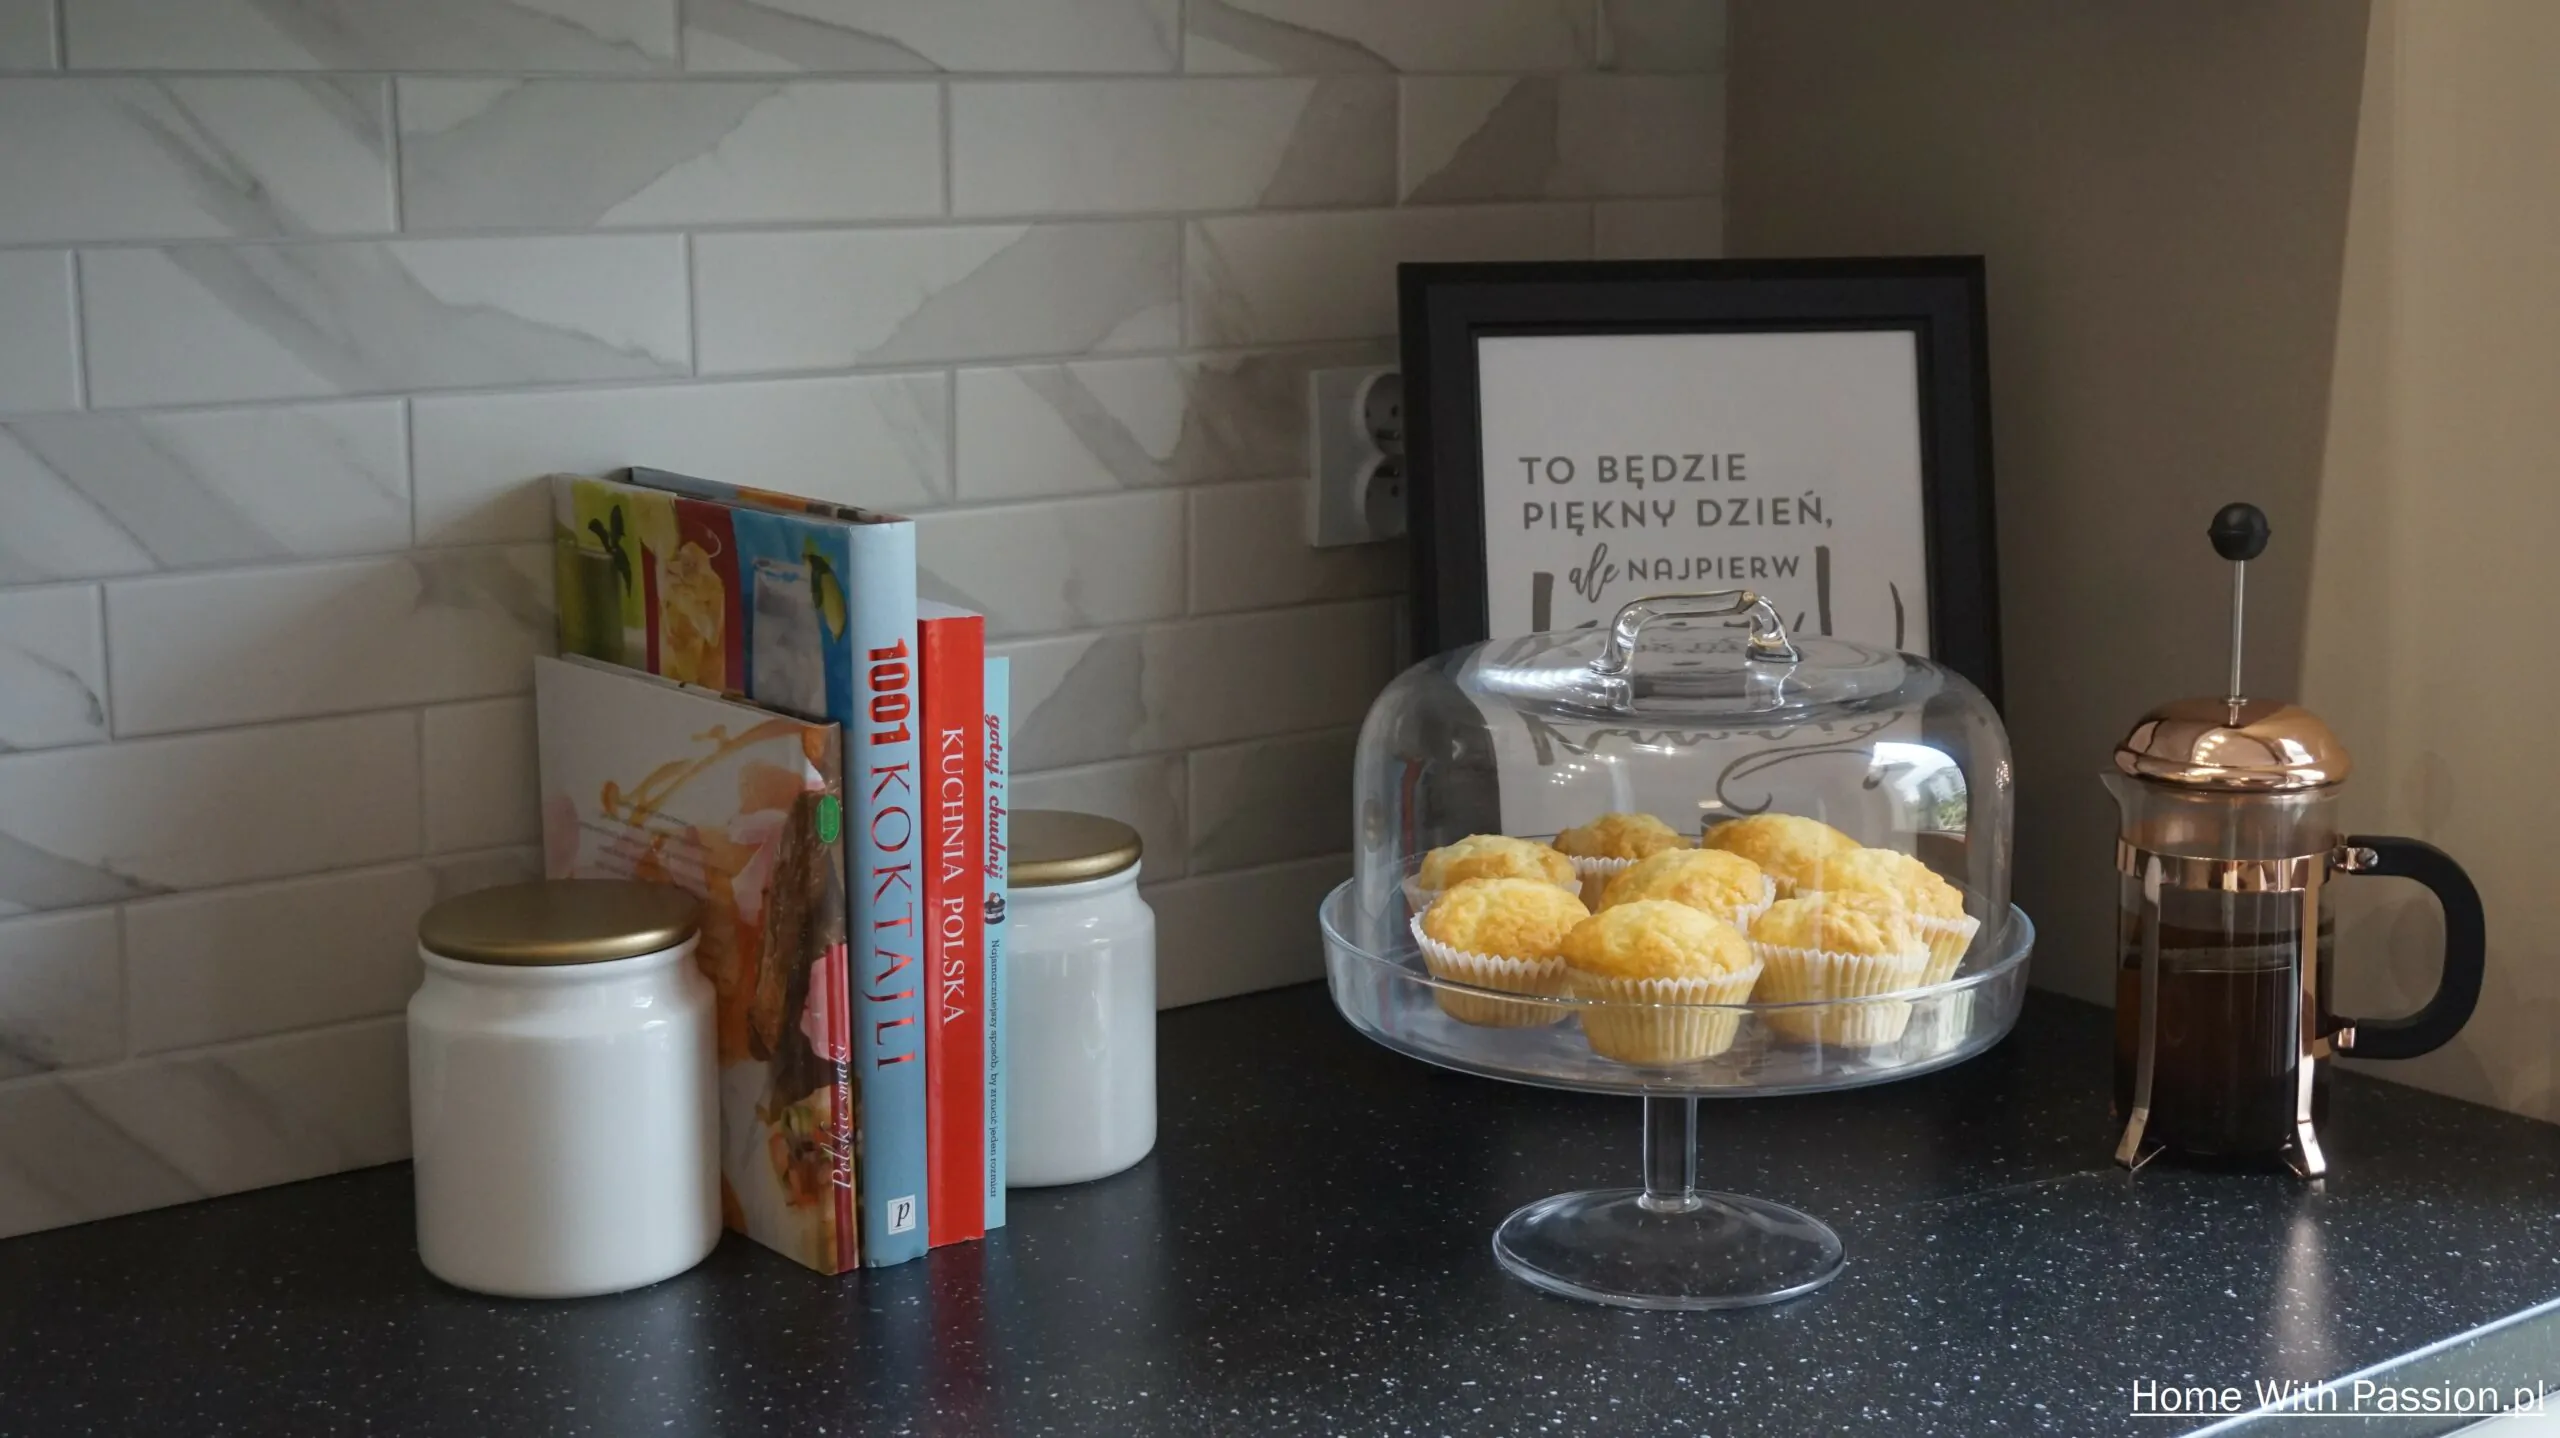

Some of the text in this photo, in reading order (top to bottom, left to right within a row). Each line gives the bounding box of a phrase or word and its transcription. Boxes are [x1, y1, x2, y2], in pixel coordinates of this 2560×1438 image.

[1519, 453, 1748, 490] TO BĘDZIE
[1522, 489, 1834, 534] PIĘKNY DZIEŃ,
[1568, 542, 1800, 603] ale NAJPIERW
[985, 713, 1007, 880] gotuj i chudnij
[861, 637, 917, 1072] 1001 KOKTAJLI
[941, 725, 967, 1026] KUCHNIA POLSKA
[988, 1072, 999, 1086] by
[819, 1044, 852, 1189] Polskie smaki
[988, 1125, 999, 1156] jeden
[990, 1157, 999, 1198] rozmiar
